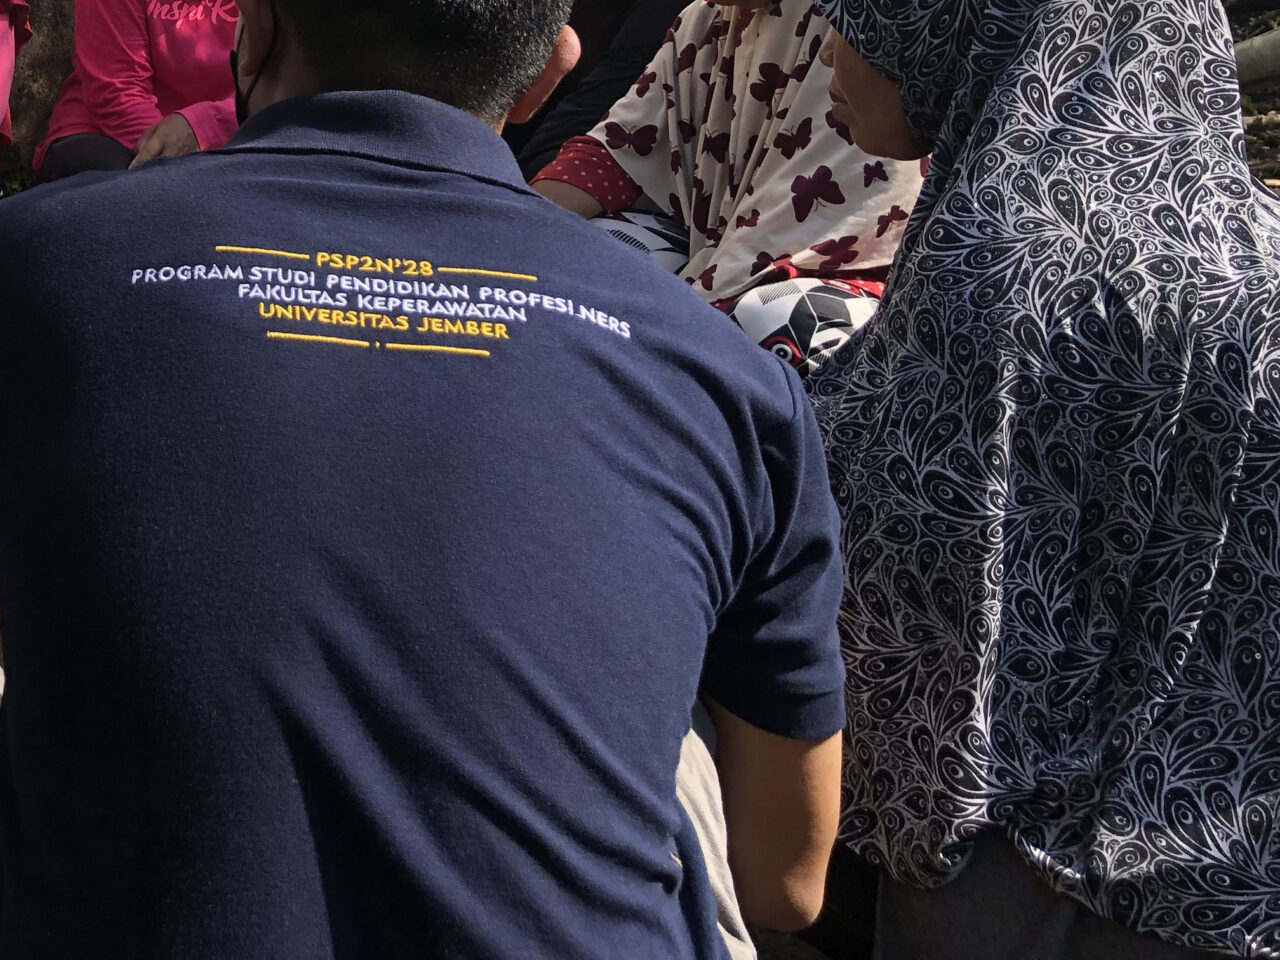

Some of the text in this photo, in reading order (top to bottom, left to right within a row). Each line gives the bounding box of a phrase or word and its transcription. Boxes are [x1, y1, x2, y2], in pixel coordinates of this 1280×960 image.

[131, 264, 631, 338] PROGRAM STUDI PENDIDIKAN PROFESI NERS
[238, 283, 528, 322] FAKULTAS KEPERAWATAN
[258, 301, 510, 339] UNIVERSITAS JEMBER
